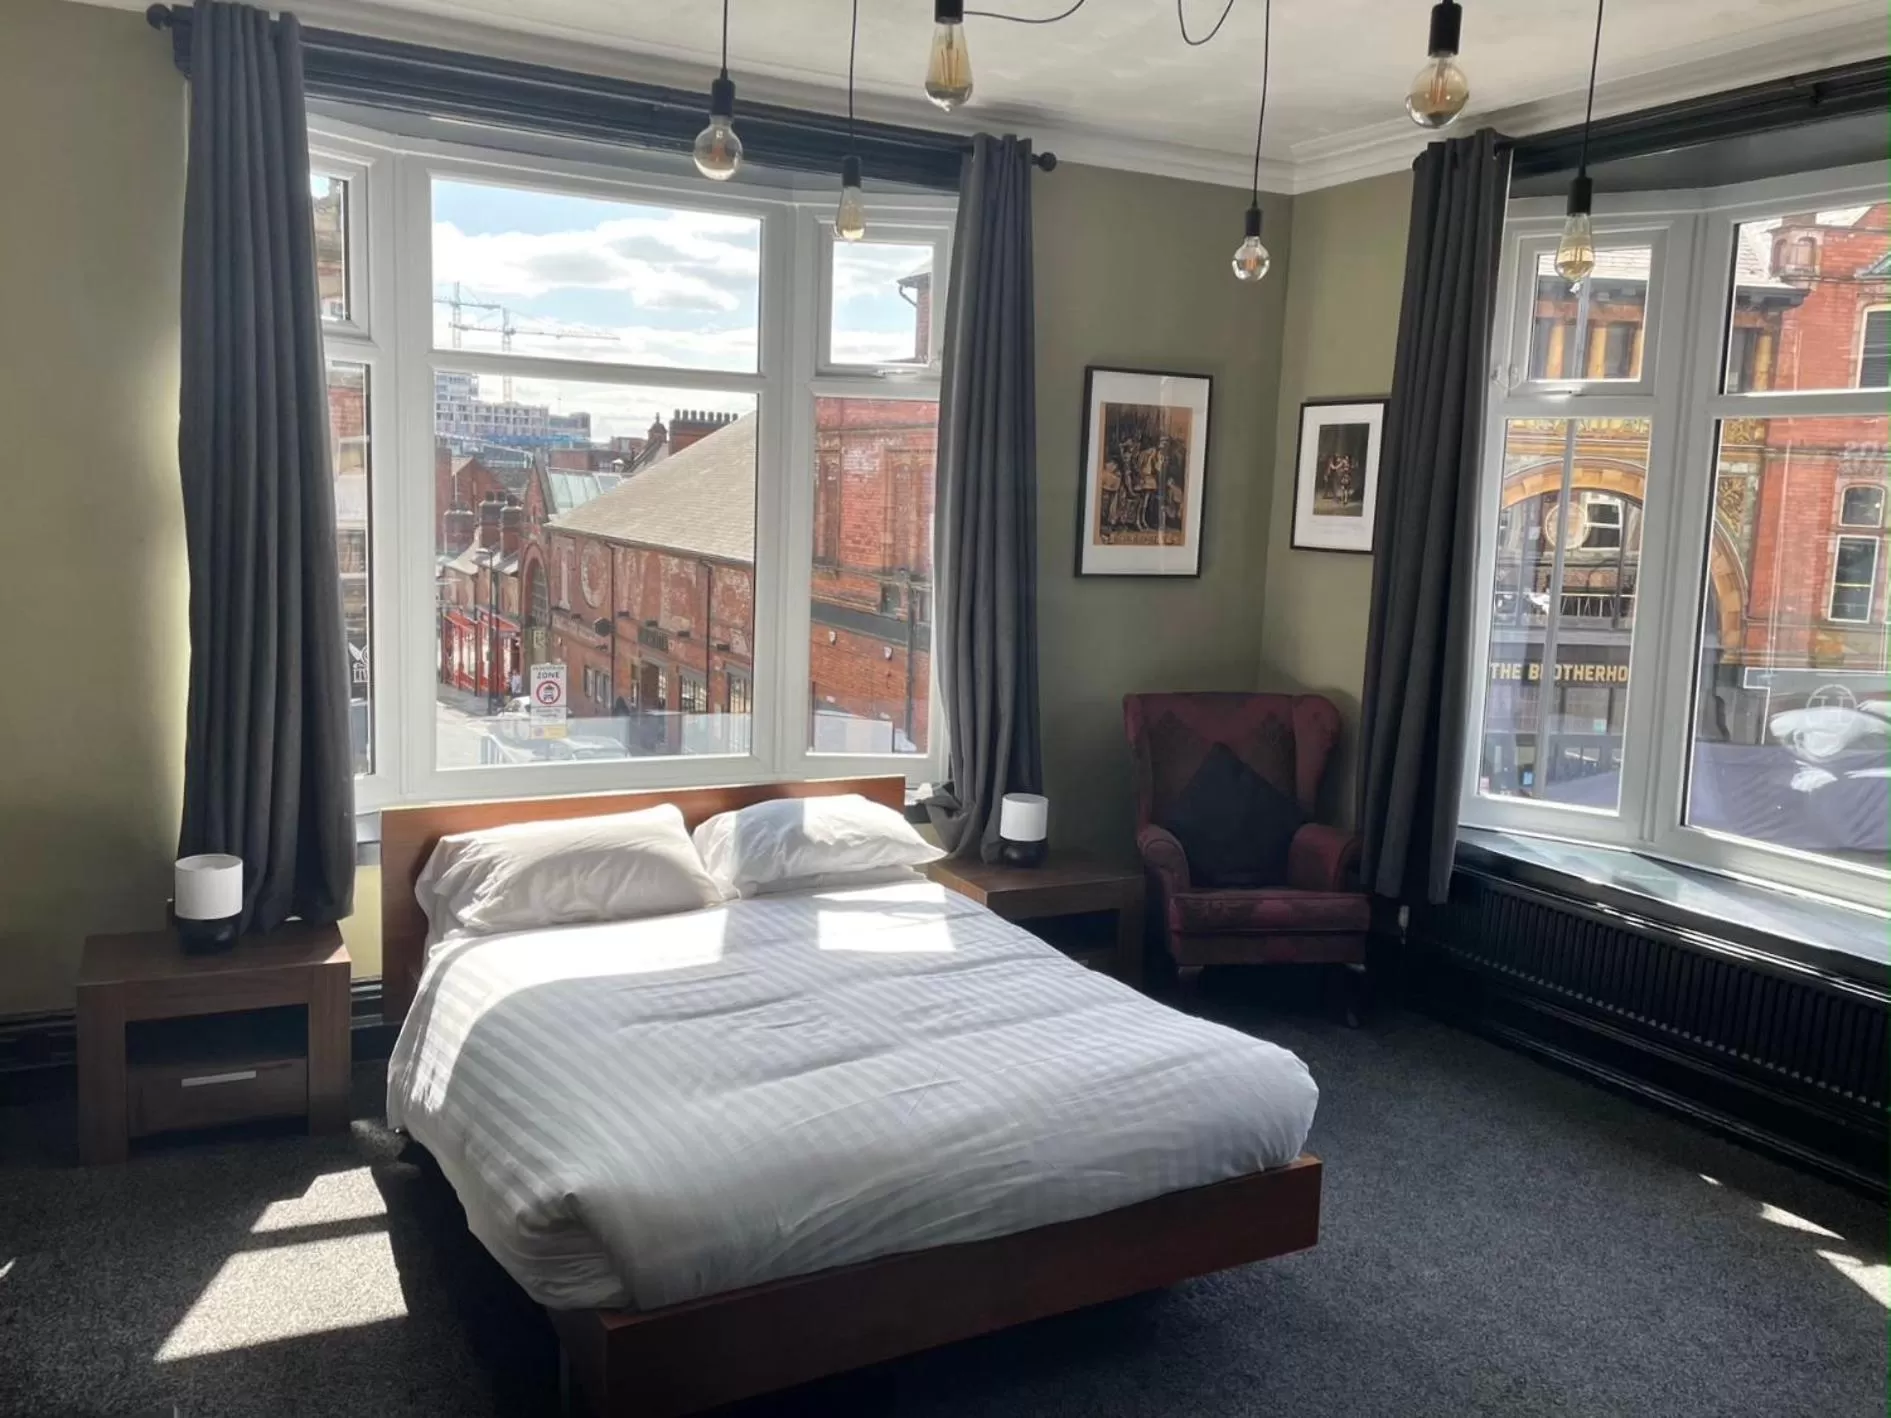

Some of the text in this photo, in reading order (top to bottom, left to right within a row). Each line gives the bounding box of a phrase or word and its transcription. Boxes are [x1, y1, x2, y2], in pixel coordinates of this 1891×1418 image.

[537, 672, 560, 680] ZONE
[1490, 662, 1629, 682] THE BOTHERHO
